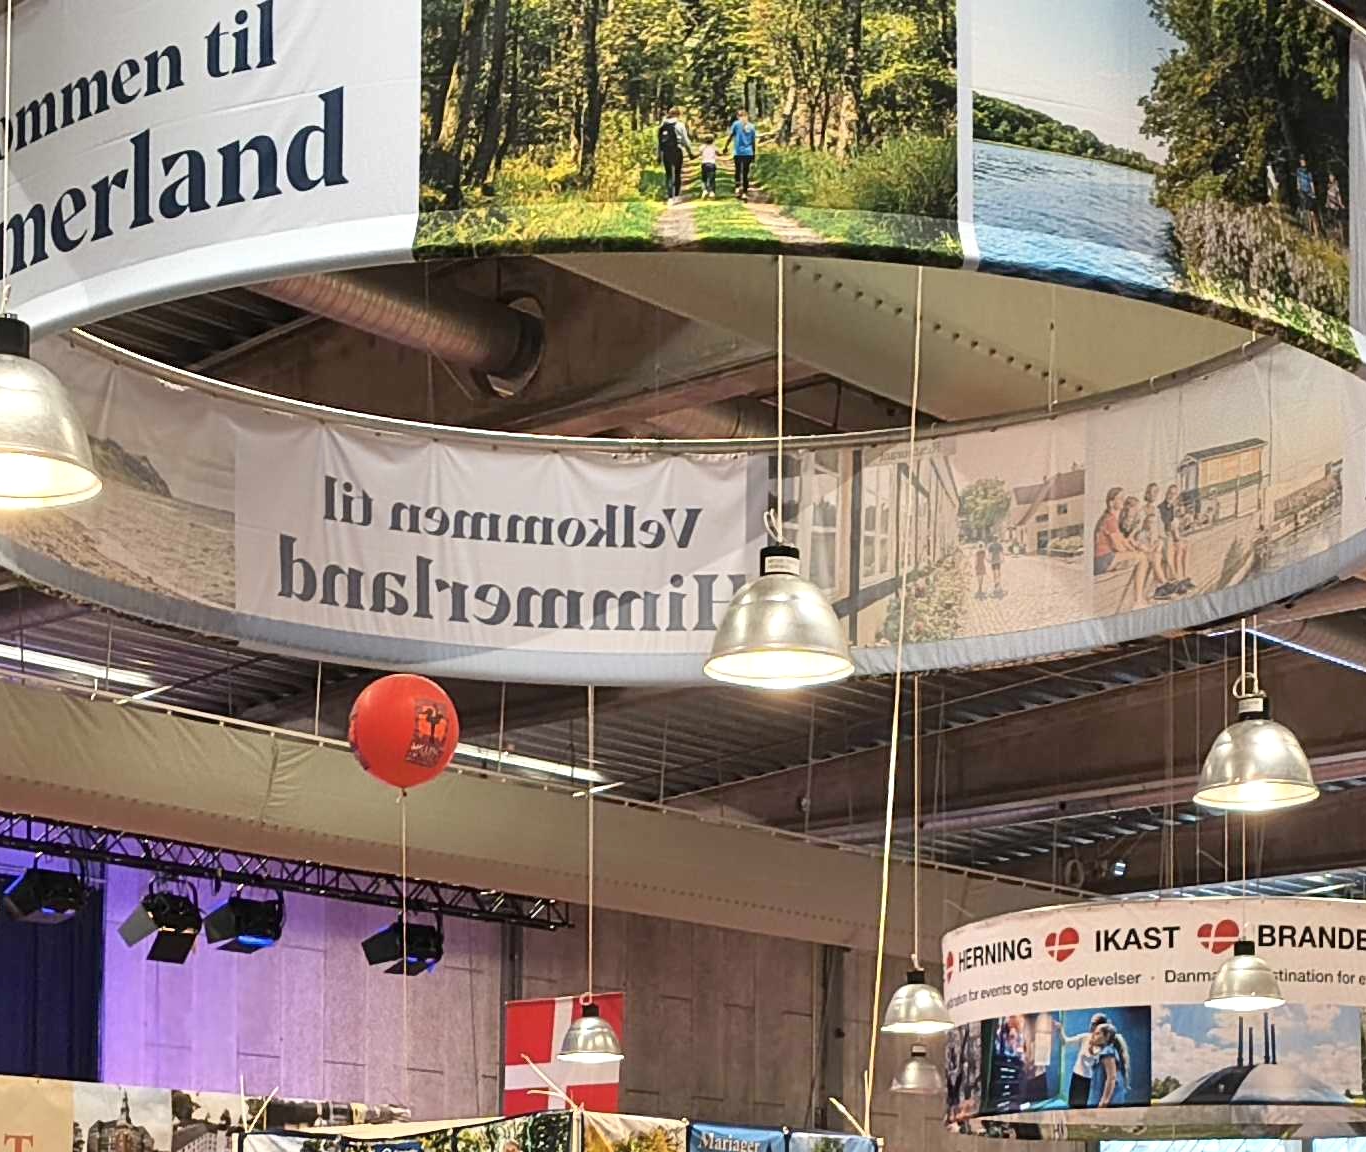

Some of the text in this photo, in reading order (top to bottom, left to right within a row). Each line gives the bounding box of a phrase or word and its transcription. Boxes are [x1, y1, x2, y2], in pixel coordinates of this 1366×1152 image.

[205, 0, 278, 79] til
[958, 938, 1032, 972] HERNING
[1095, 926, 1180, 952] IKAST
[1014, 982, 1029, 996] og
[1033, 977, 1064, 992] store
[1067, 971, 1142, 989] oplevelser
[1337, 970, 1355, 985] for
